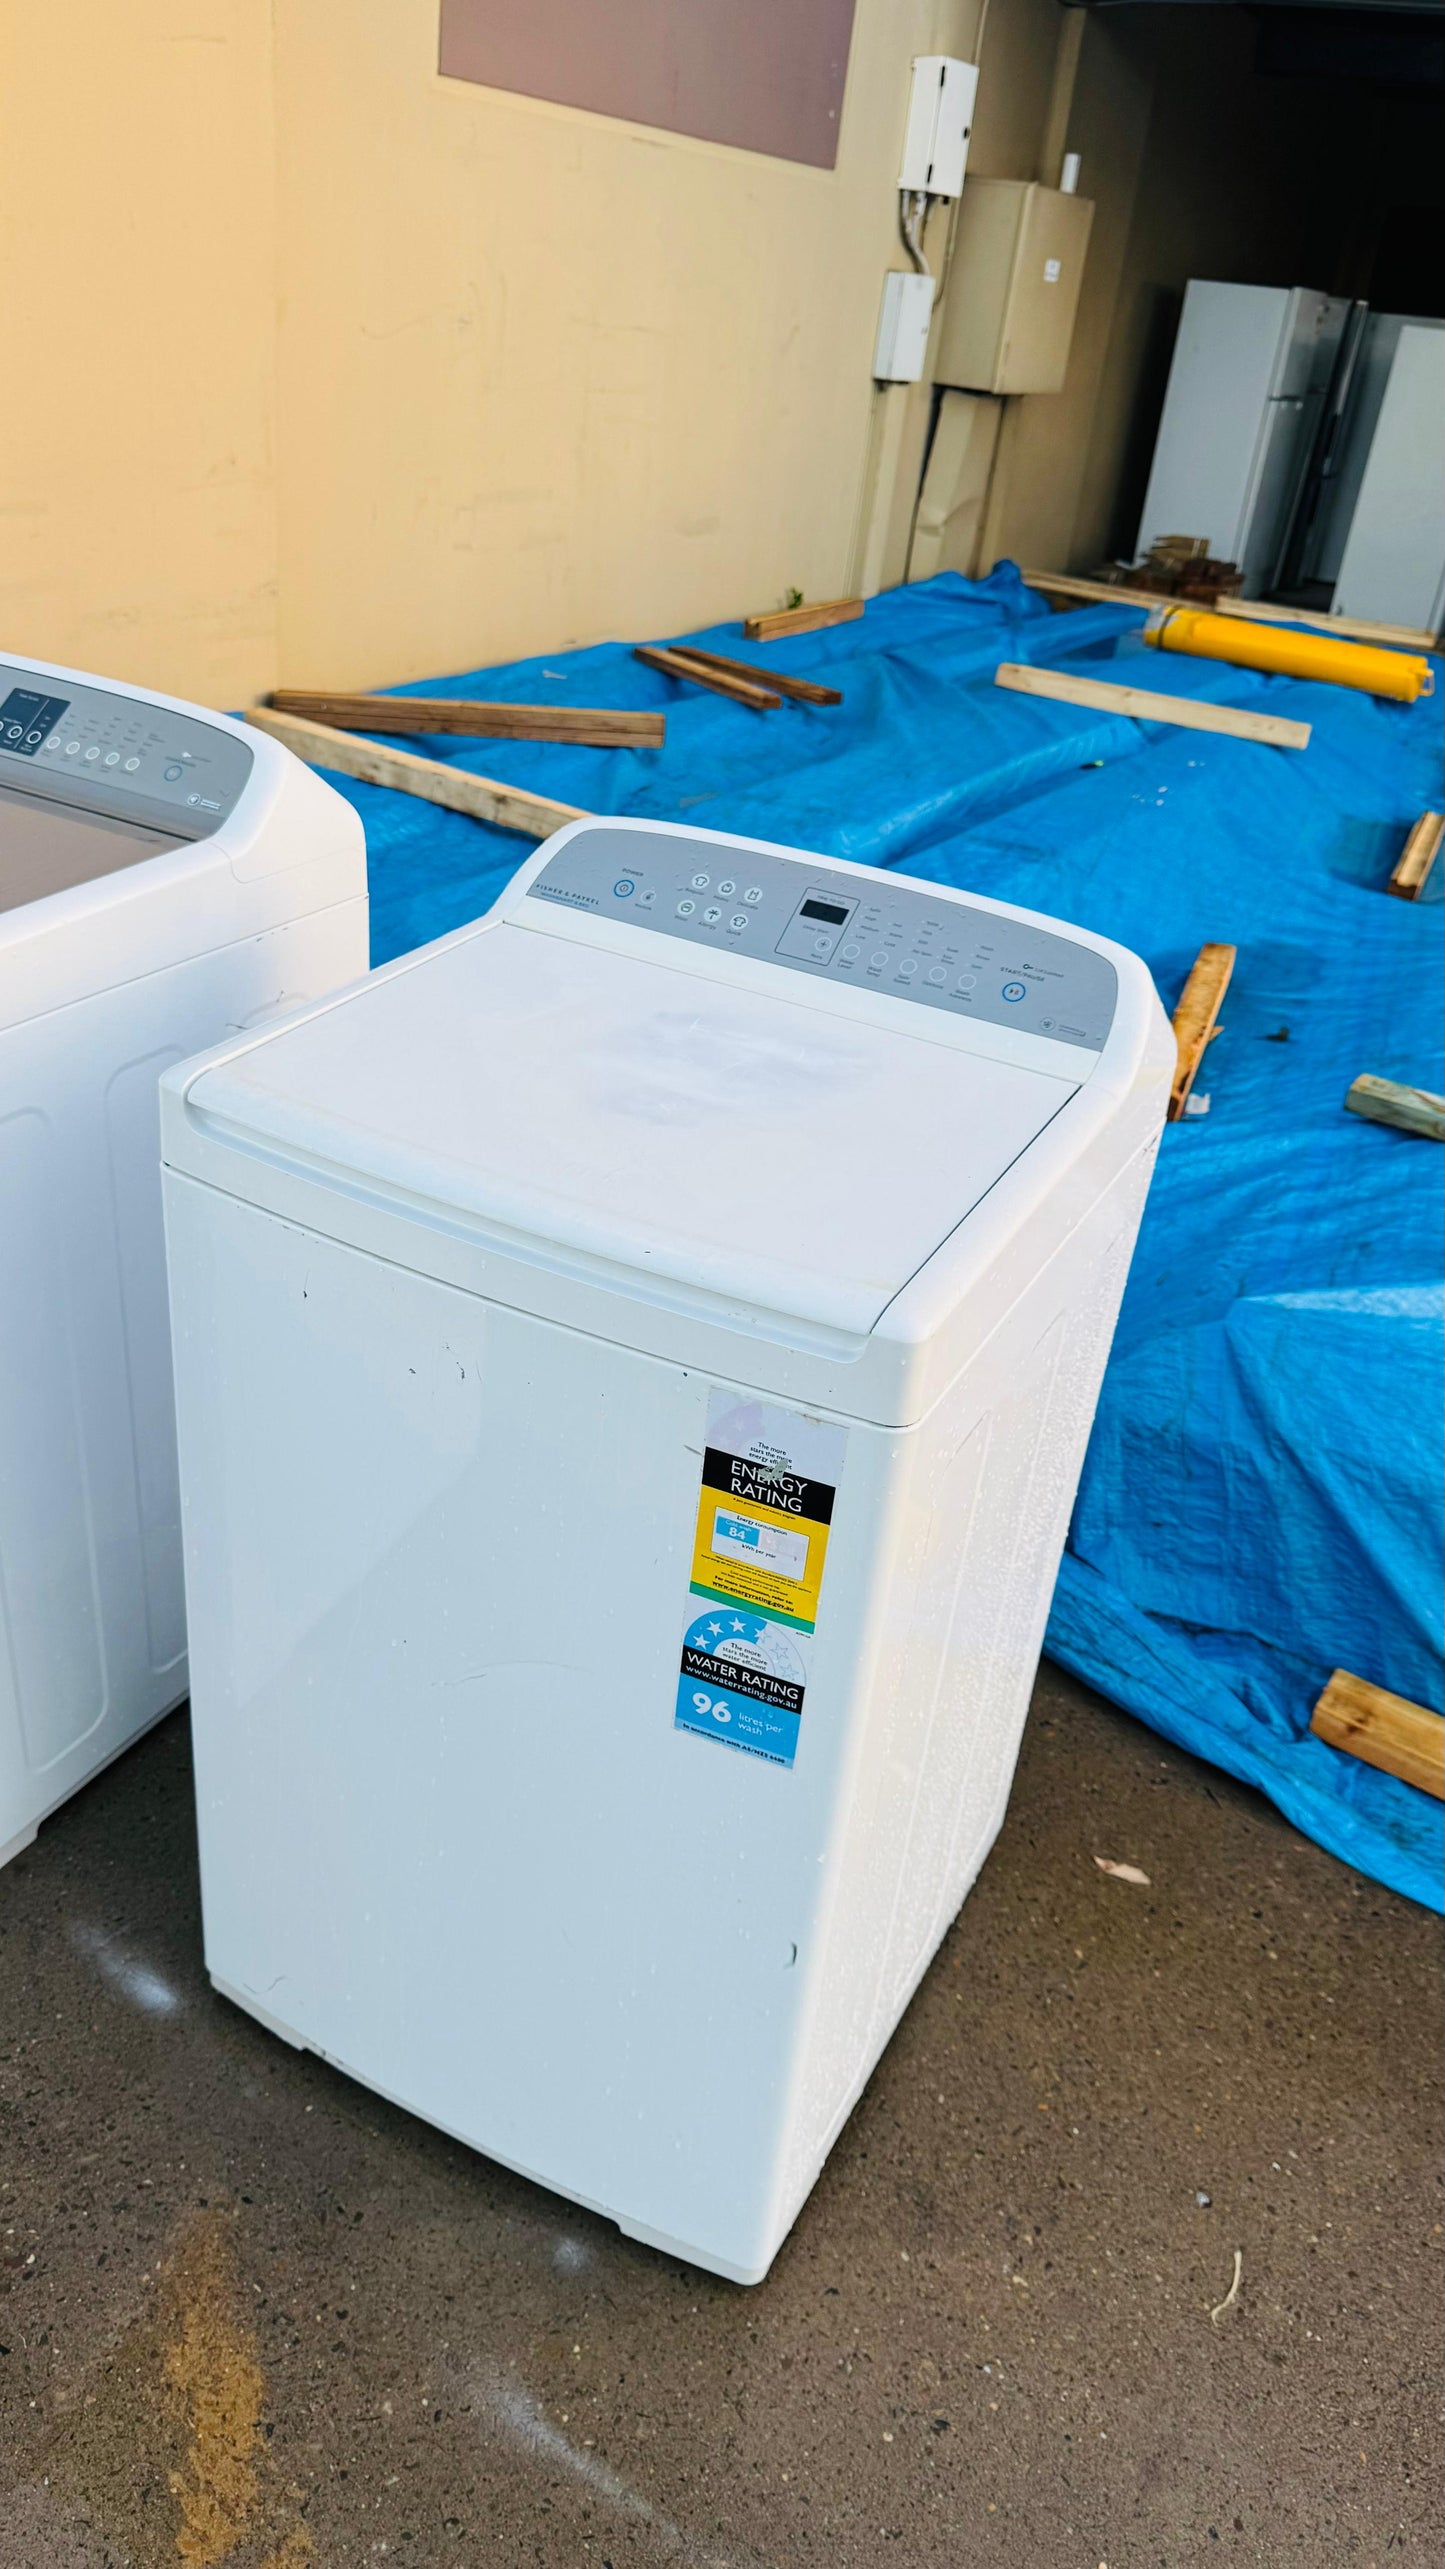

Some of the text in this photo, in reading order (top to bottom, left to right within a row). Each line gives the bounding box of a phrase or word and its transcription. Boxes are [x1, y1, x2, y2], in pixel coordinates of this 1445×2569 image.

[622, 868, 644, 877] POWER
[536, 884, 563, 895] FISHER
[571, 893, 599, 905] PAYKEL
[748, 1452, 769, 1463] energy
[750, 1447, 765, 1455] stars
[758, 1441, 787, 1456] The more
[731, 1478, 802, 1513] RATING
[728, 1526, 746, 1540] 84
[736, 1515, 788, 1536] Energy consumption
[741, 1544, 755, 1552] kWh
[722, 1647, 768, 1666] stars the more
[731, 1642, 762, 1658] The more
[722, 1653, 767, 1672] water efficient
[687, 1651, 799, 1700] WATER RATING
[686, 1666, 797, 1709] www.waterrating.gov.au
[692, 1692, 732, 1723] 96
[738, 1722, 763, 1736] wash
[739, 1712, 784, 1734] litres per
